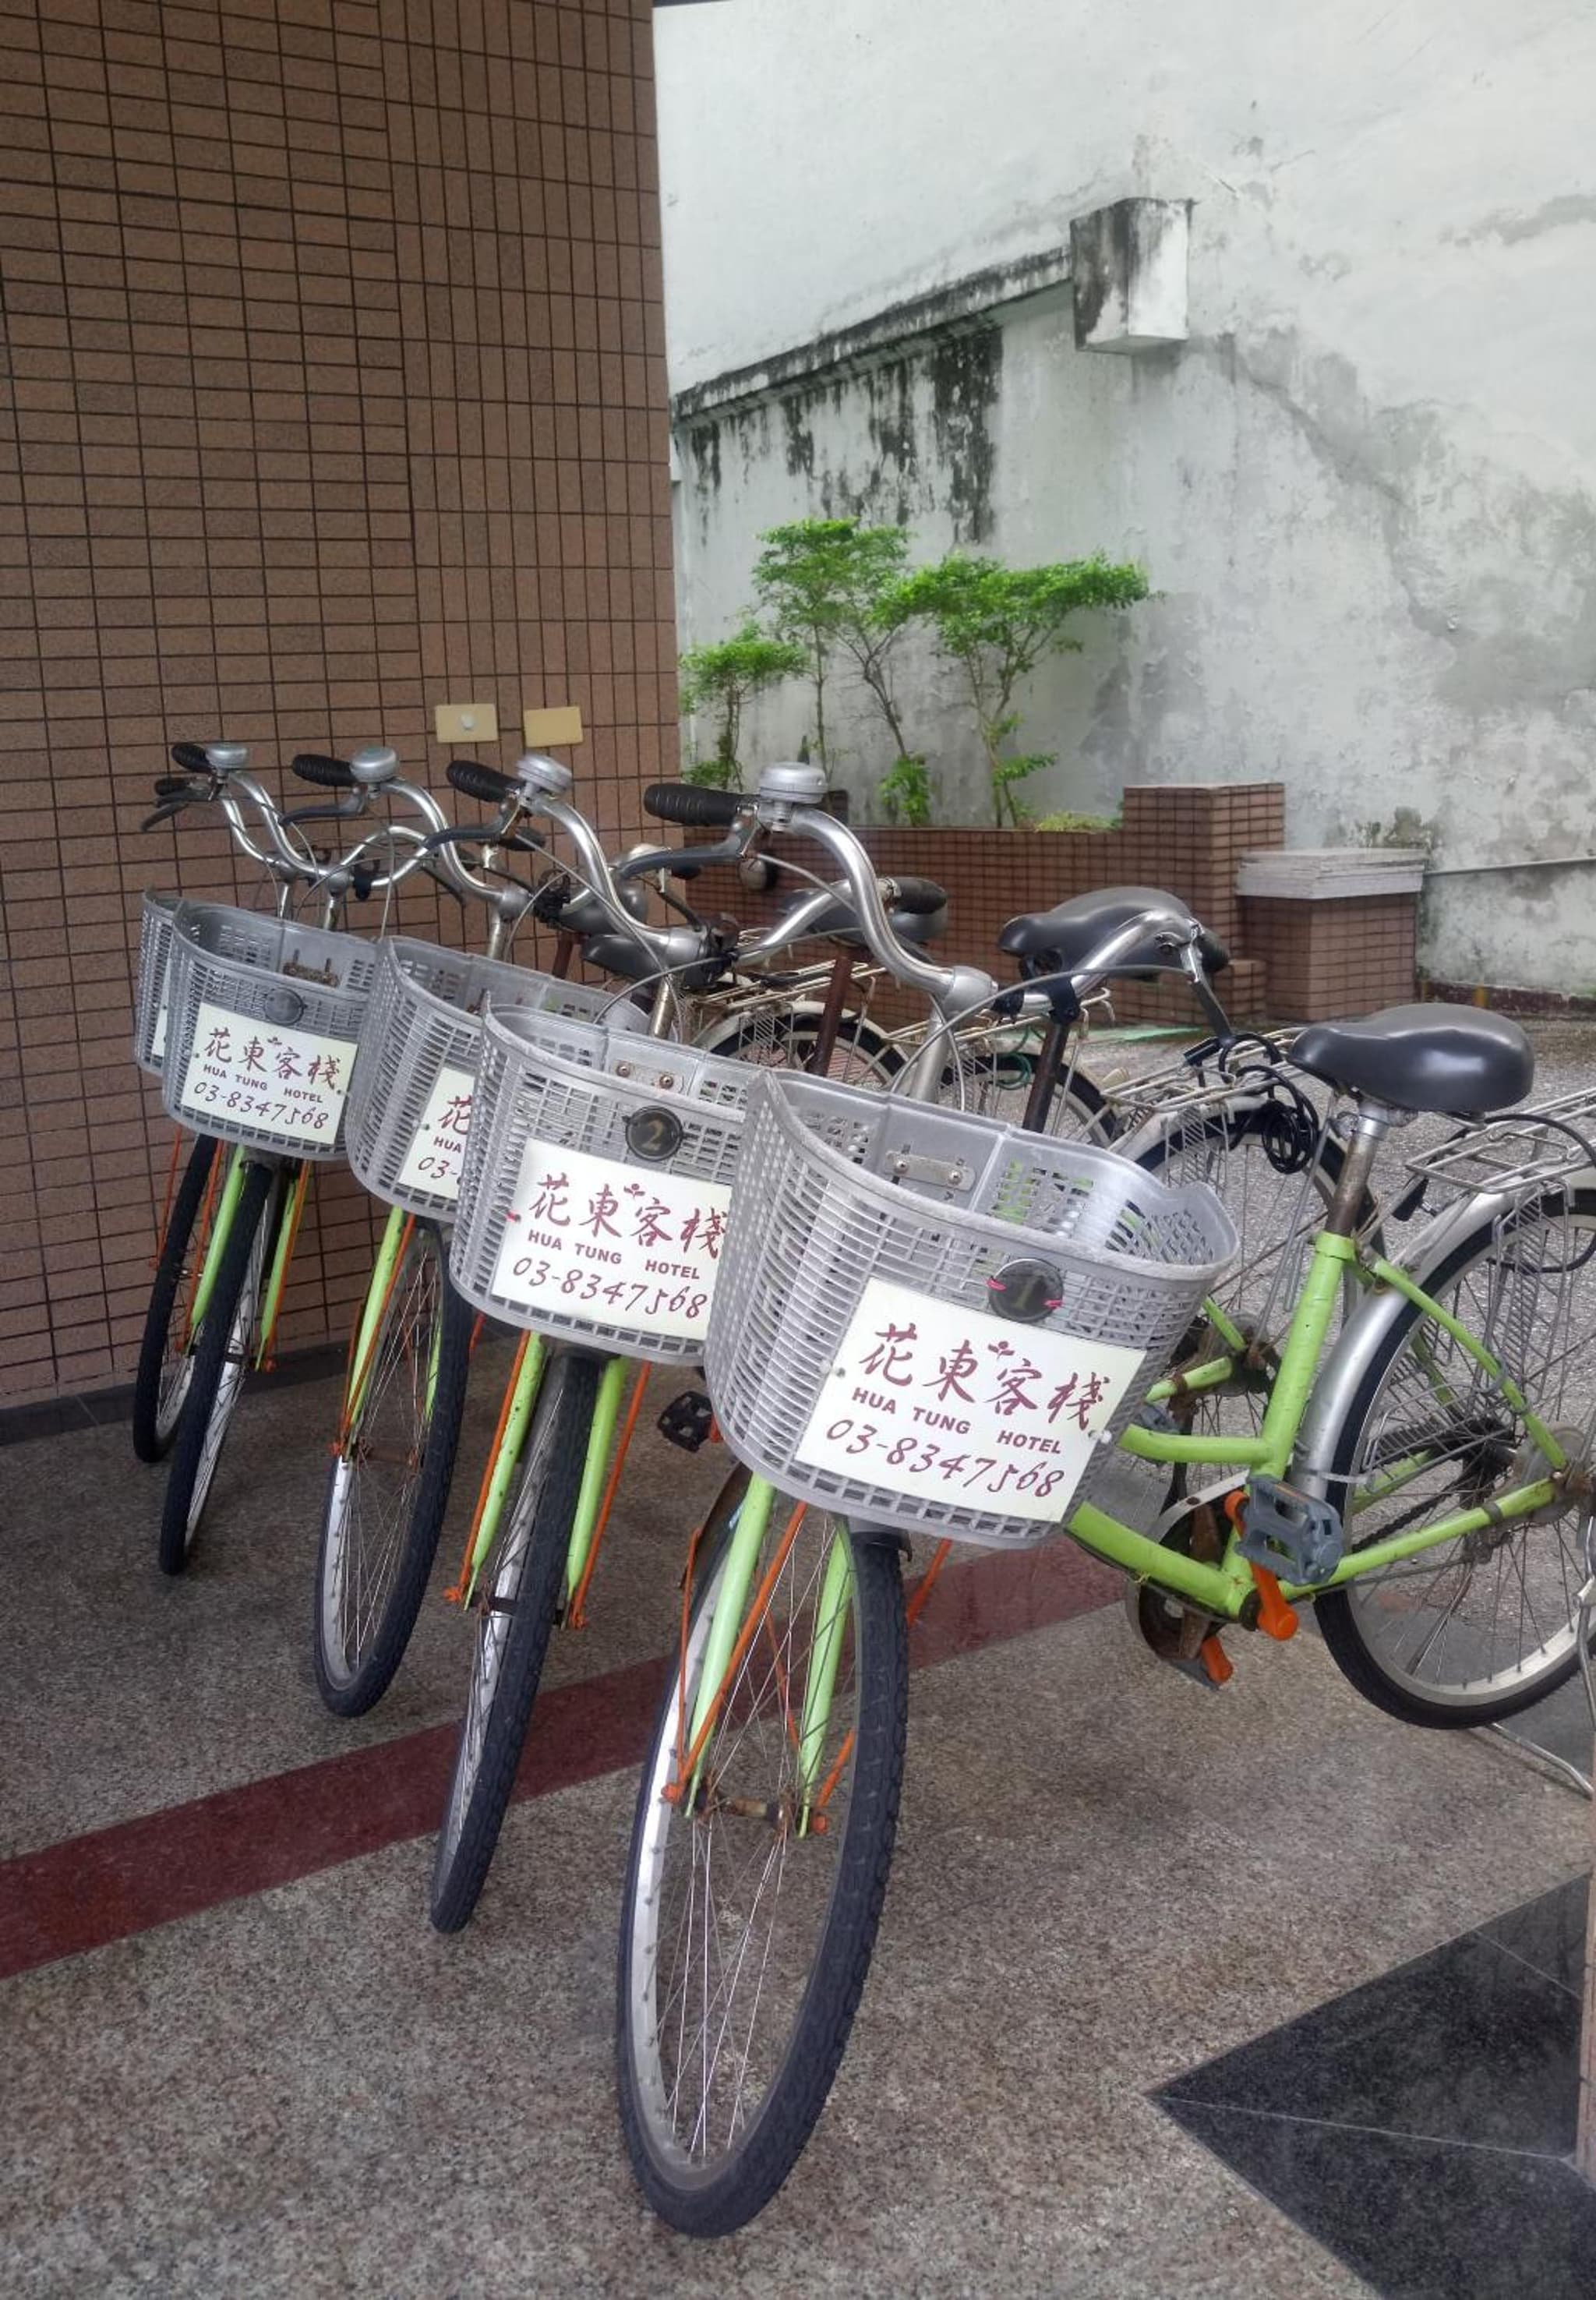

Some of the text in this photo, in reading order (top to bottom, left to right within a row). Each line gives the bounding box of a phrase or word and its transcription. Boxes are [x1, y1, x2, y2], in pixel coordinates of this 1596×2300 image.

[203, 1026, 341, 1091] 花東客棧
[203, 1063, 323, 1104] HUA TUNG HOTEL
[193, 1082, 330, 1129] 03-8347568
[641, 1119, 663, 1151] 2
[433, 1136, 462, 1154] HUA
[528, 1171, 728, 1260] 花東客棧
[527, 1229, 701, 1280] HUA TUNG HOTEL
[512, 1256, 708, 1320] 03-8347568
[859, 1323, 1111, 1433] 花東客棧
[852, 1387, 1061, 1455] HUA TUNG HOTEL
[826, 1419, 1066, 1497] 03-8347568
